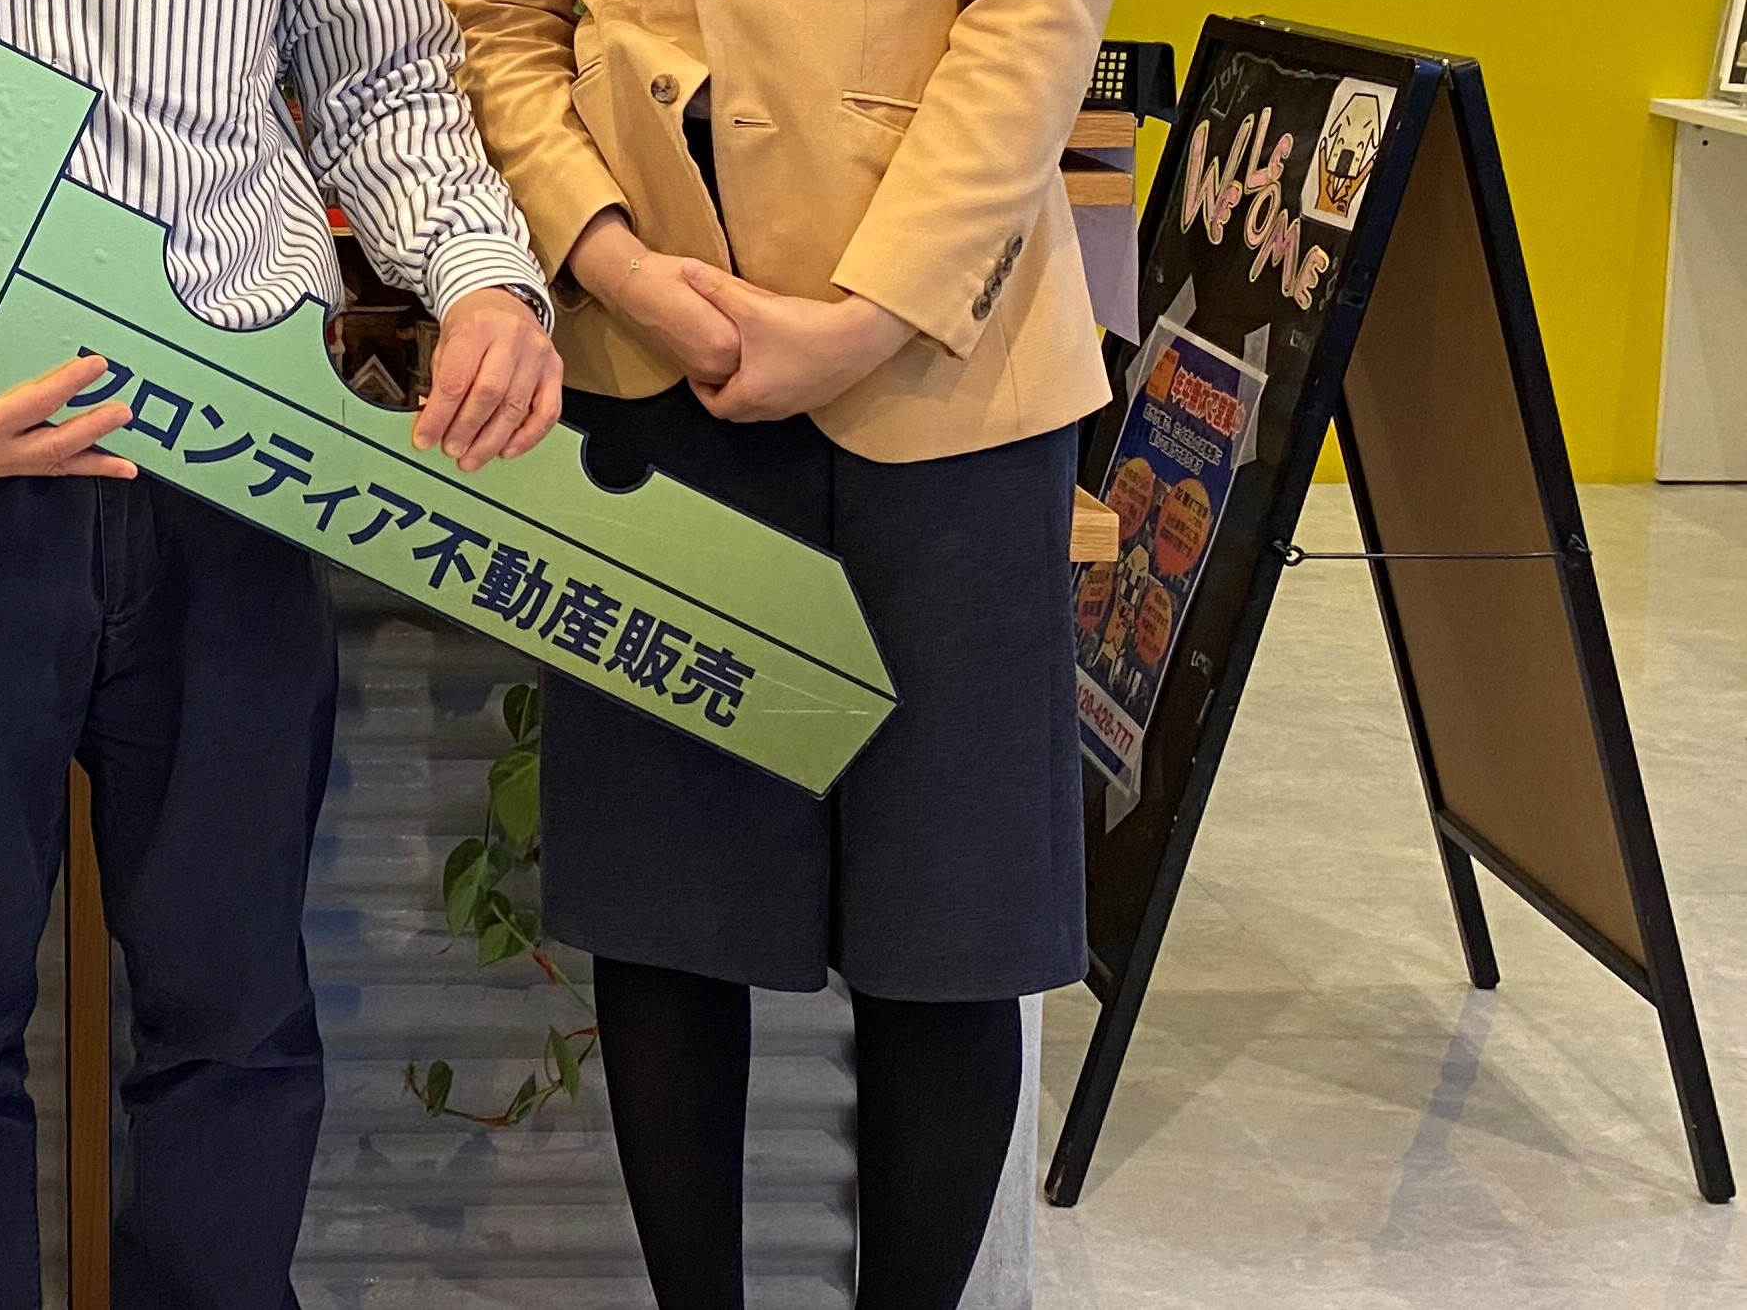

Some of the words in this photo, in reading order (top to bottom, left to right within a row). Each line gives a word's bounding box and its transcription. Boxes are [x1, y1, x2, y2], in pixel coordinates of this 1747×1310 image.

[67, 345, 756, 728] フロンティア不動産販売
[1077, 684, 1135, 755] 120-428-777
